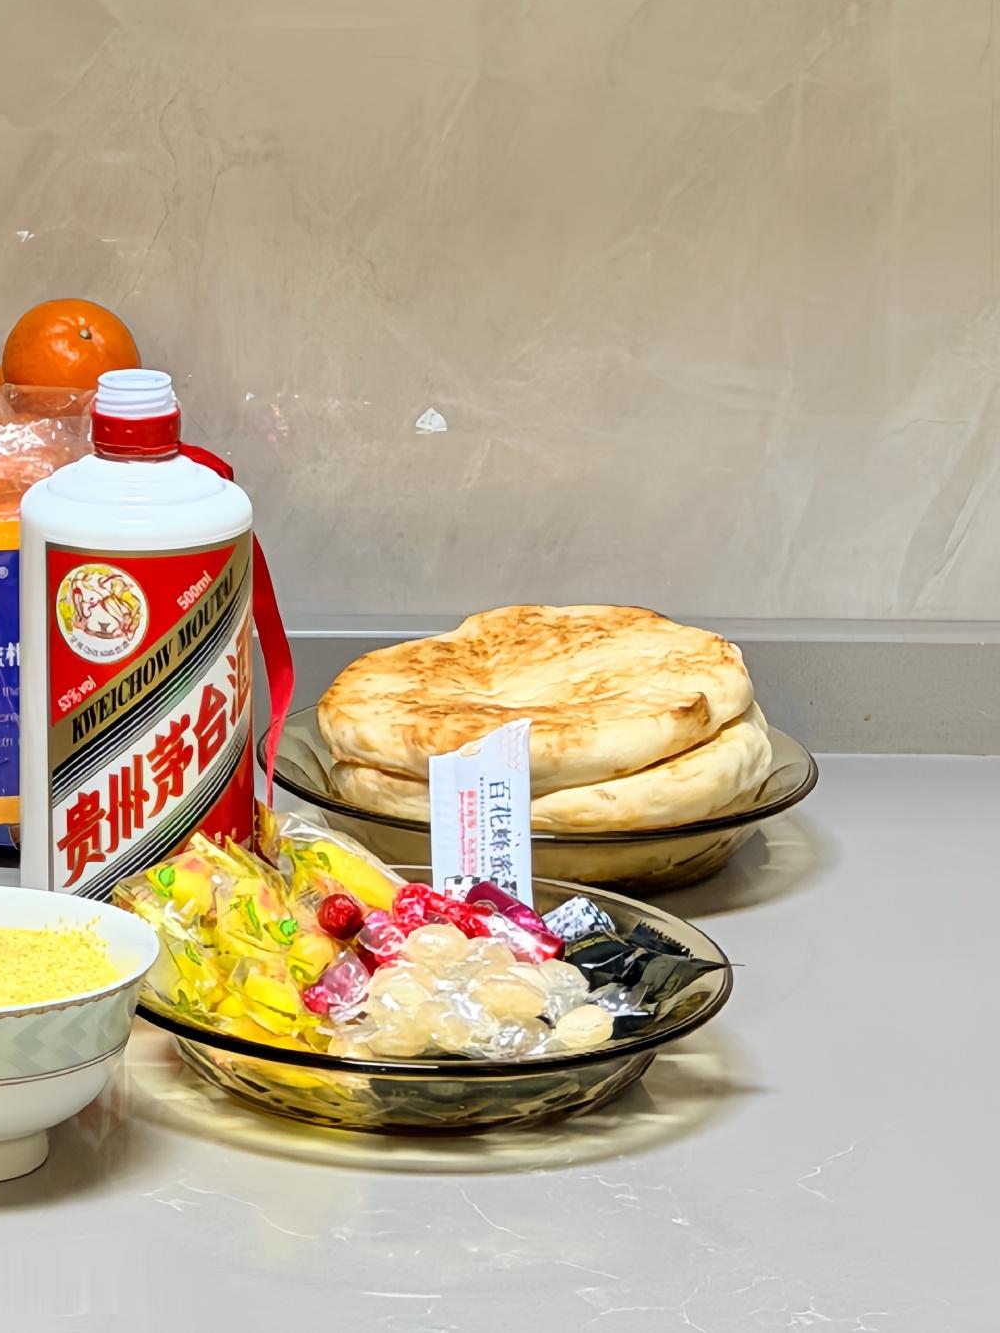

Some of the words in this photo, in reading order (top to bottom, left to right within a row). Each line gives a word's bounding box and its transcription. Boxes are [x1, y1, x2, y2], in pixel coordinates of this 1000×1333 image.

[56, 614, 252, 888] 贵州茅台酒
[72, 637, 174, 745] KWEICHOW
[177, 566, 235, 657] MOUTAI
